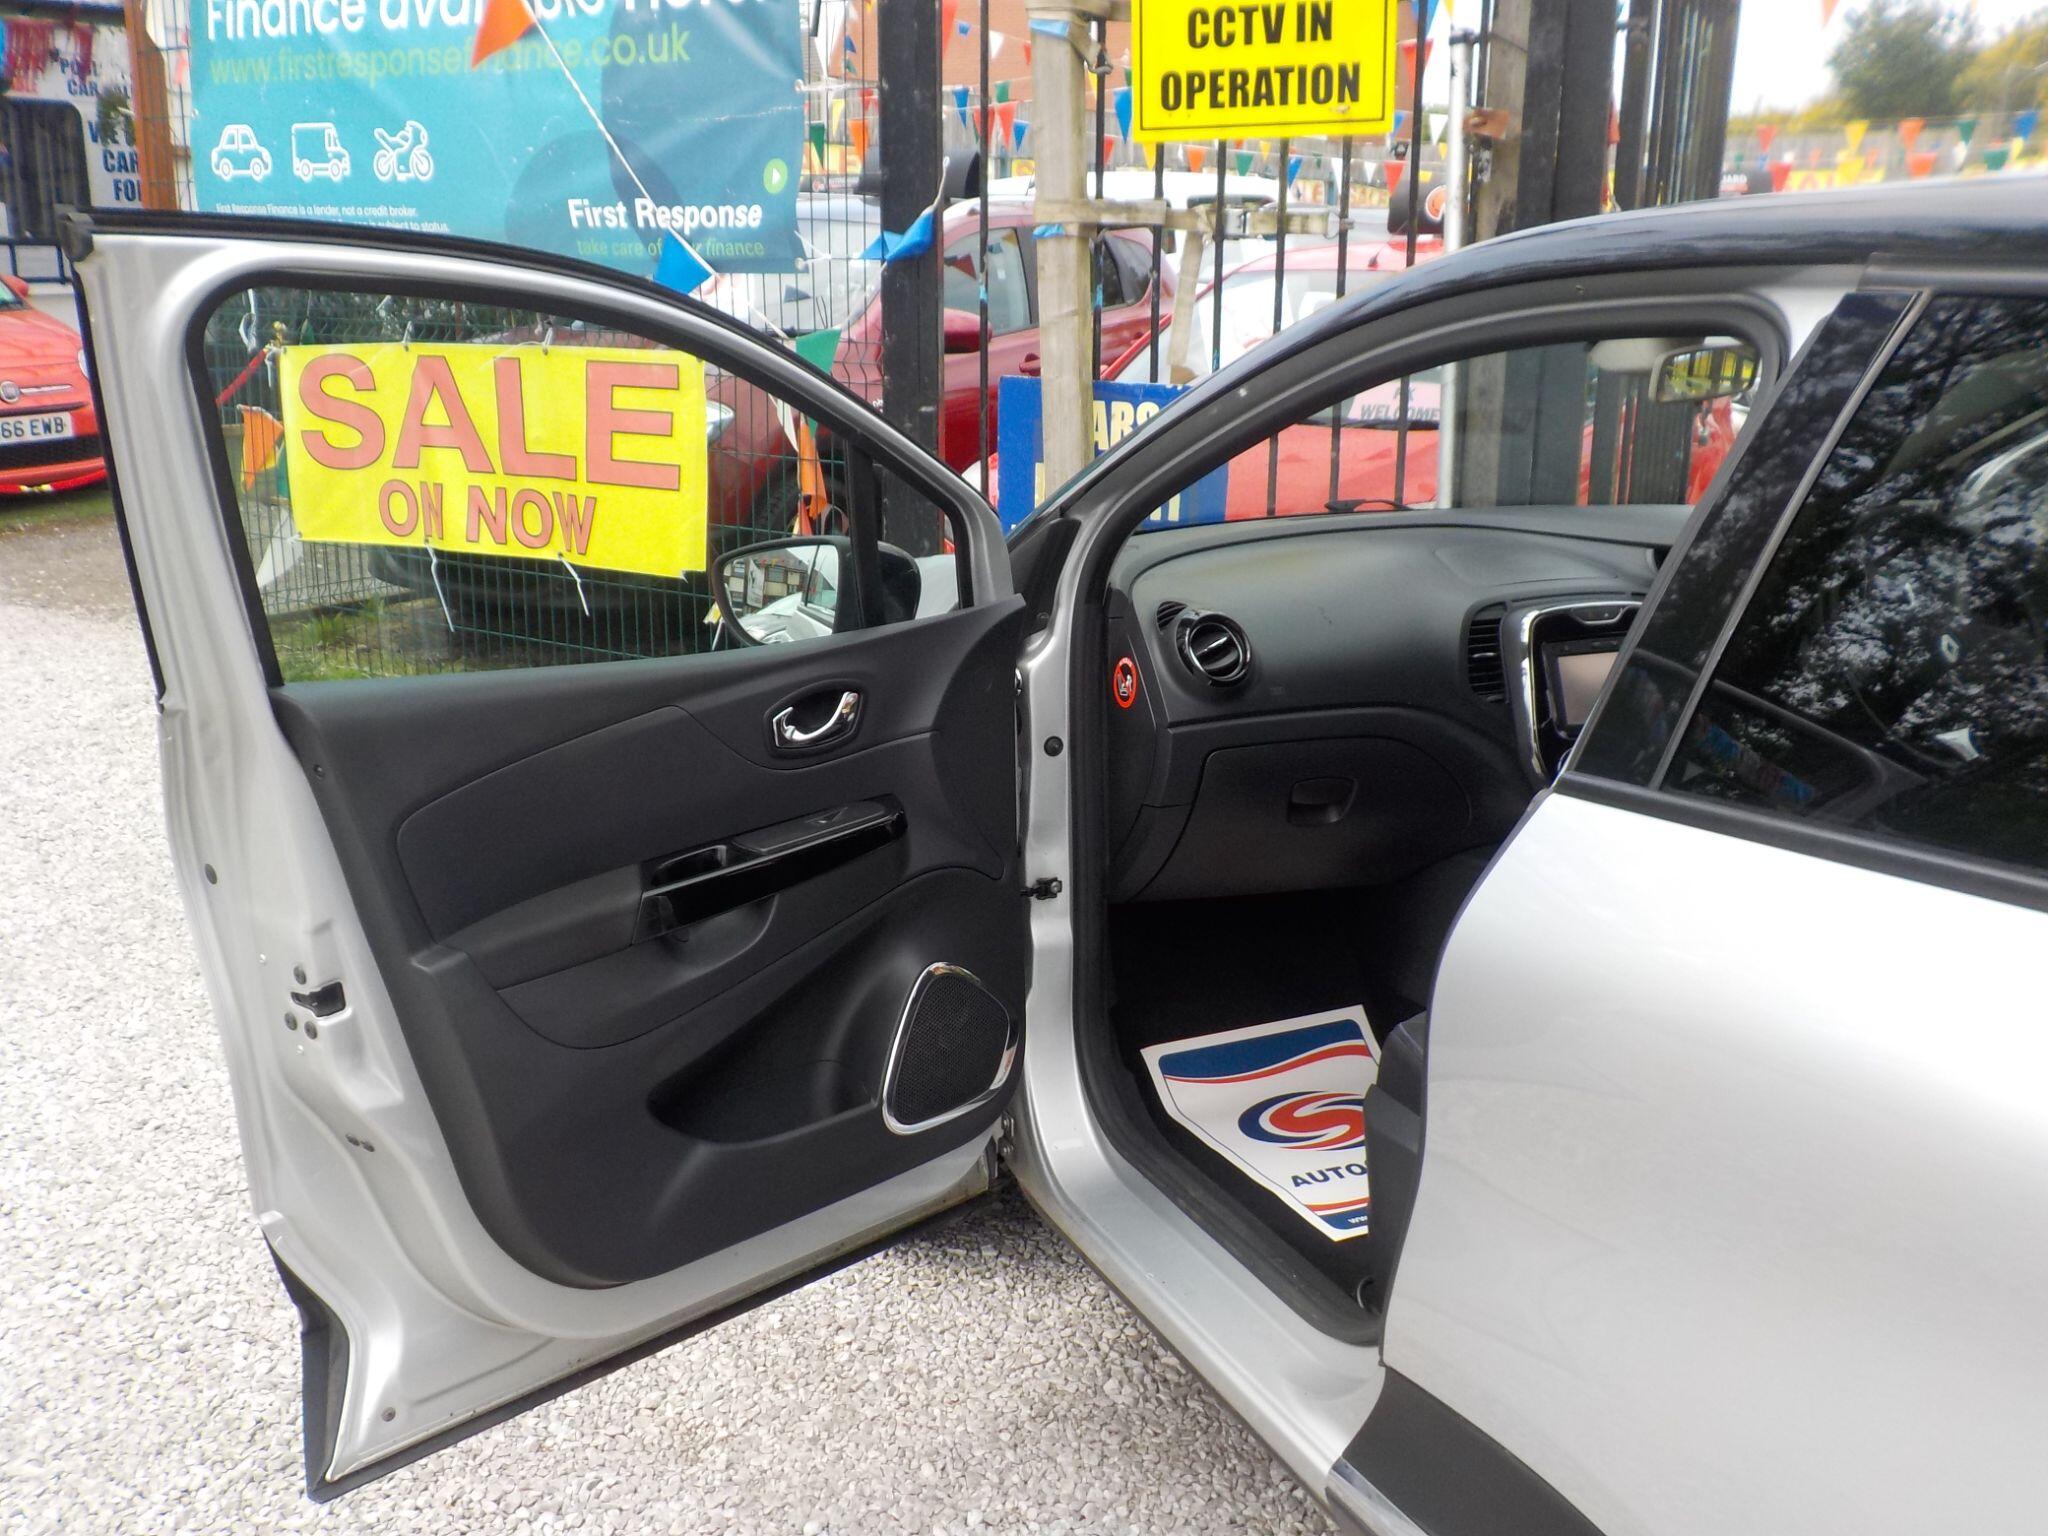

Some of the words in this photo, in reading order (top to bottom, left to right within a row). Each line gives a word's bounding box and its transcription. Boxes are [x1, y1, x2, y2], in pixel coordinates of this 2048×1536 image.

[206, 0, 366, 41] Finance
[1187, 2, 1286, 49] CCTV
[1295, 0, 1334, 43] IN
[209, 22, 690, 88] www.firstresponsefance.co.uk
[1160, 62, 1361, 112] OPERATION
[568, 198, 628, 229] First
[633, 197, 763, 236] Response
[576, 238, 607, 256] take
[611, 240, 645, 257] care
[647, 238, 662, 256] of
[706, 238, 765, 257] finance
[30, 416, 64, 436] EWB
[298, 353, 680, 491] SALE
[378, 479, 444, 540] ON
[466, 484, 597, 555] NOW
